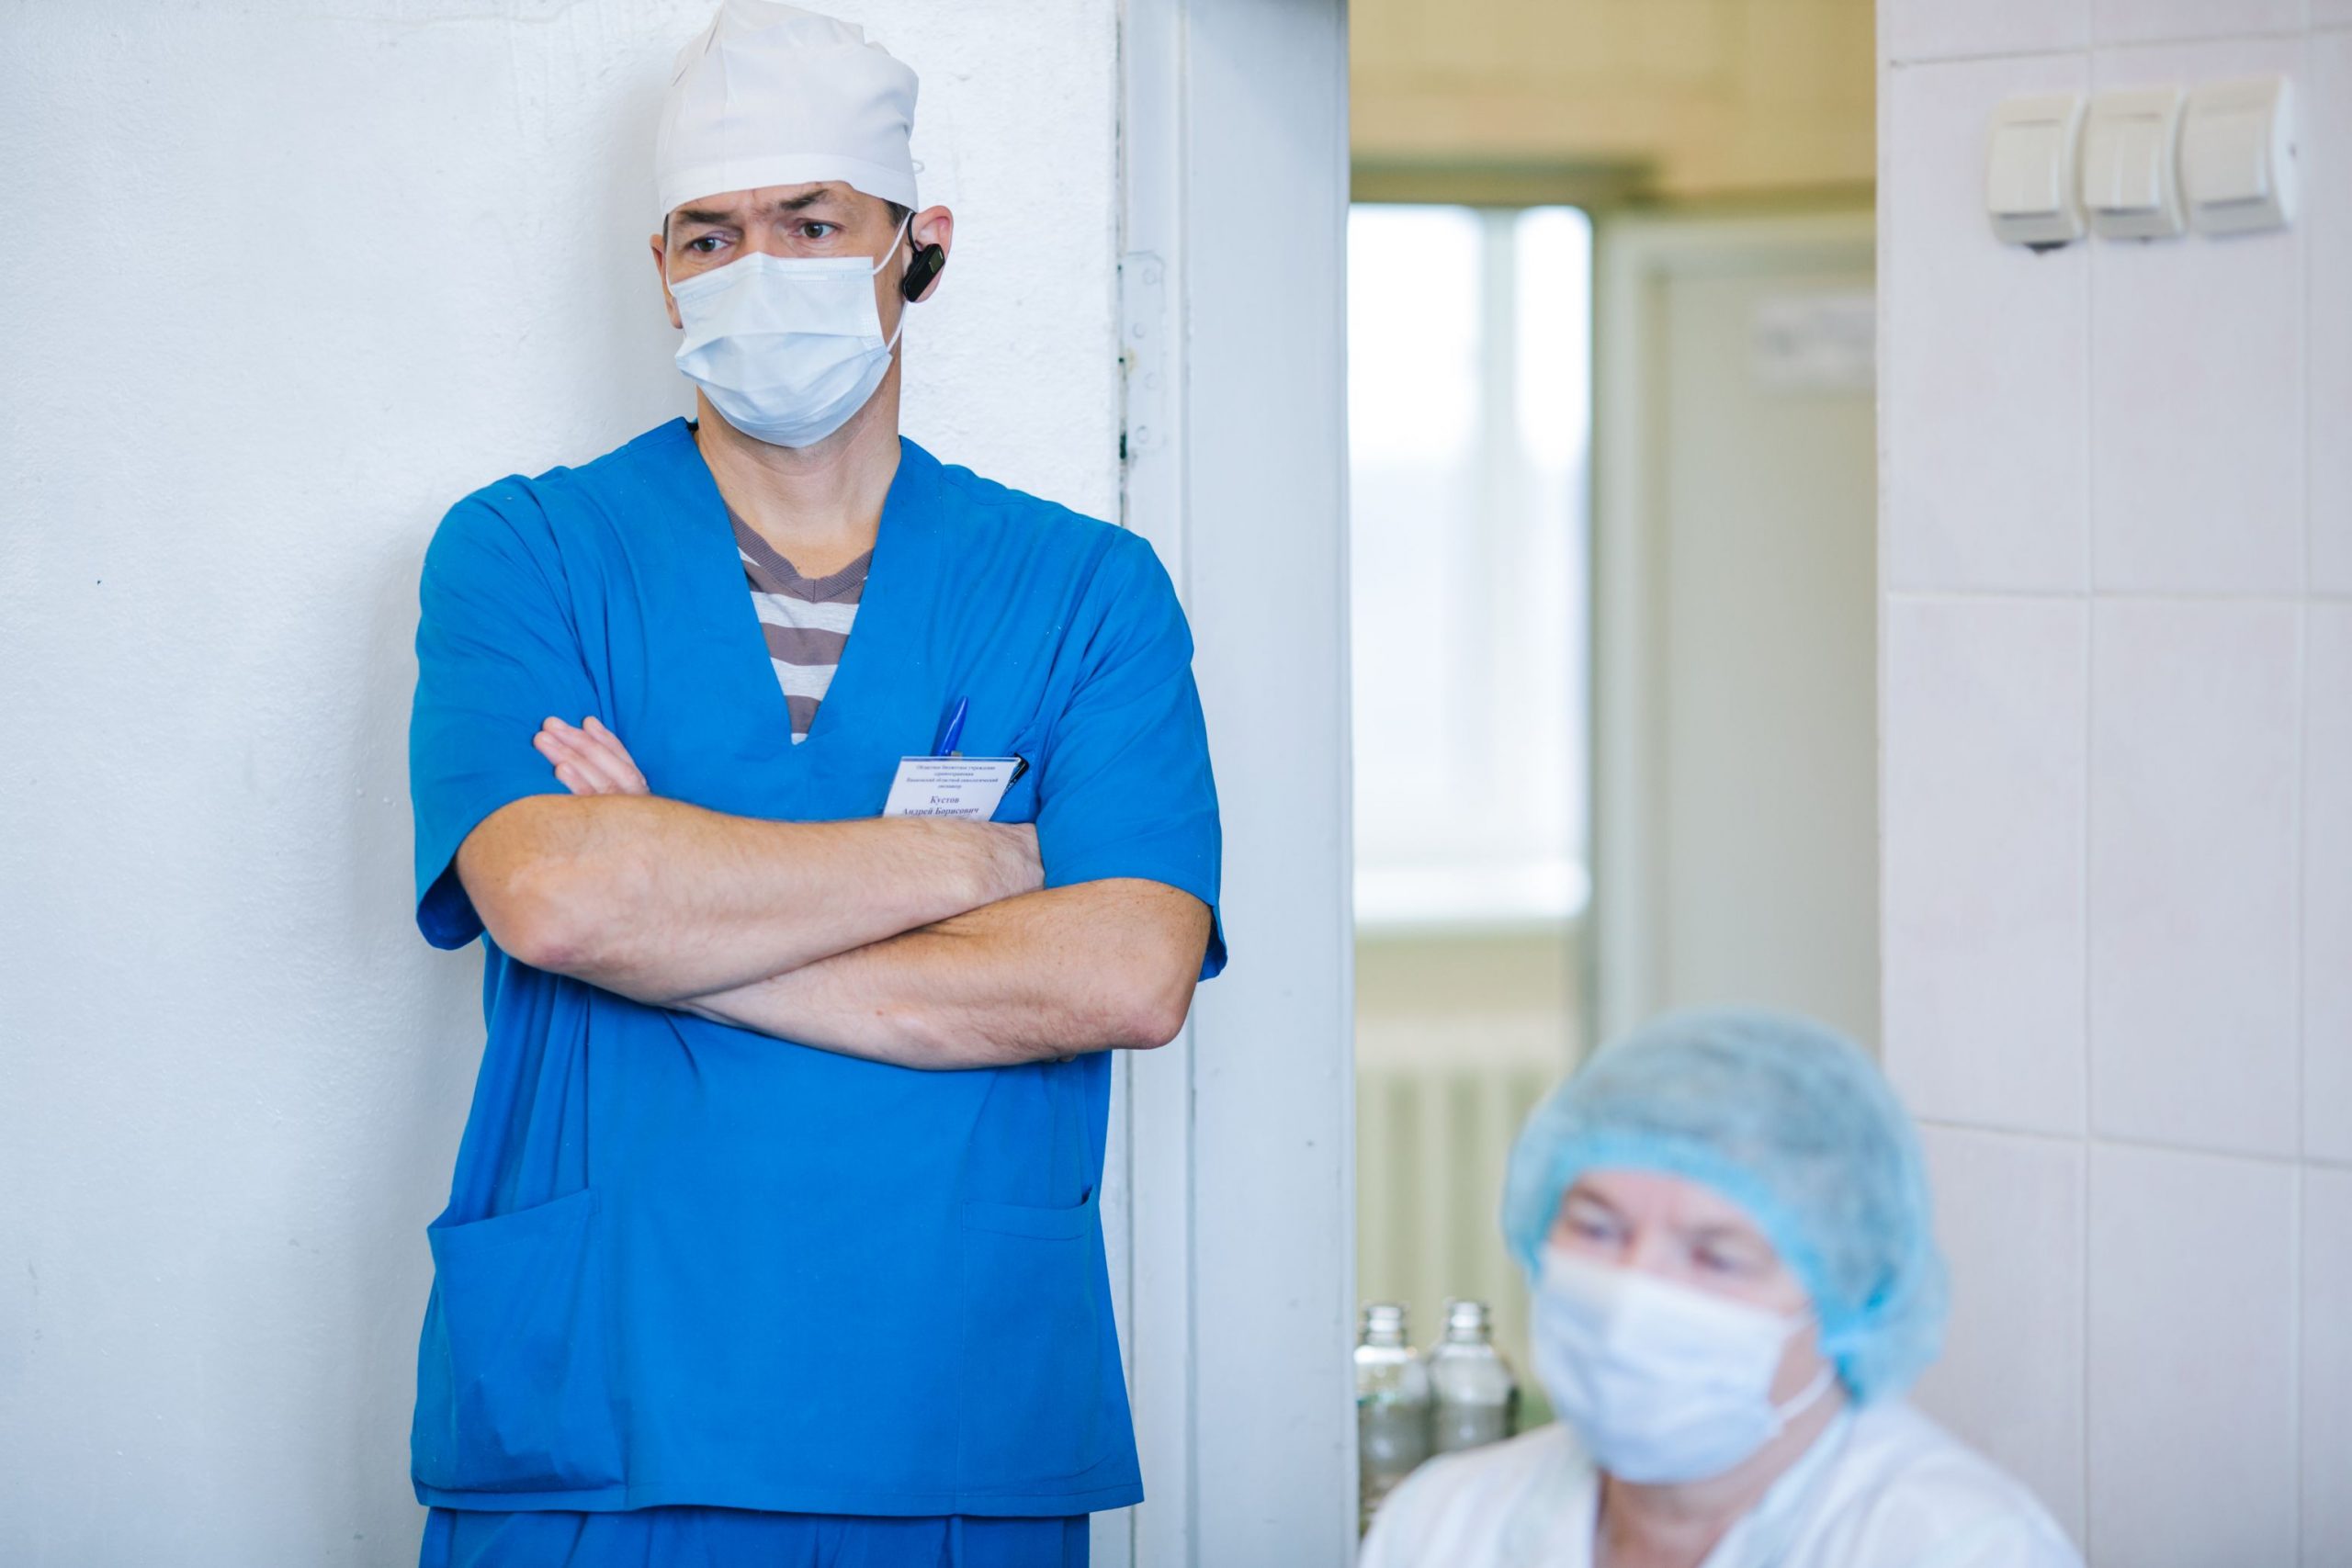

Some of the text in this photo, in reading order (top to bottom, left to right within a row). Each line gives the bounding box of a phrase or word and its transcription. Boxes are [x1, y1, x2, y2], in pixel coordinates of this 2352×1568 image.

[930, 795, 960, 806] Кустов
[903, 807, 979, 817] Андрей Борисович
